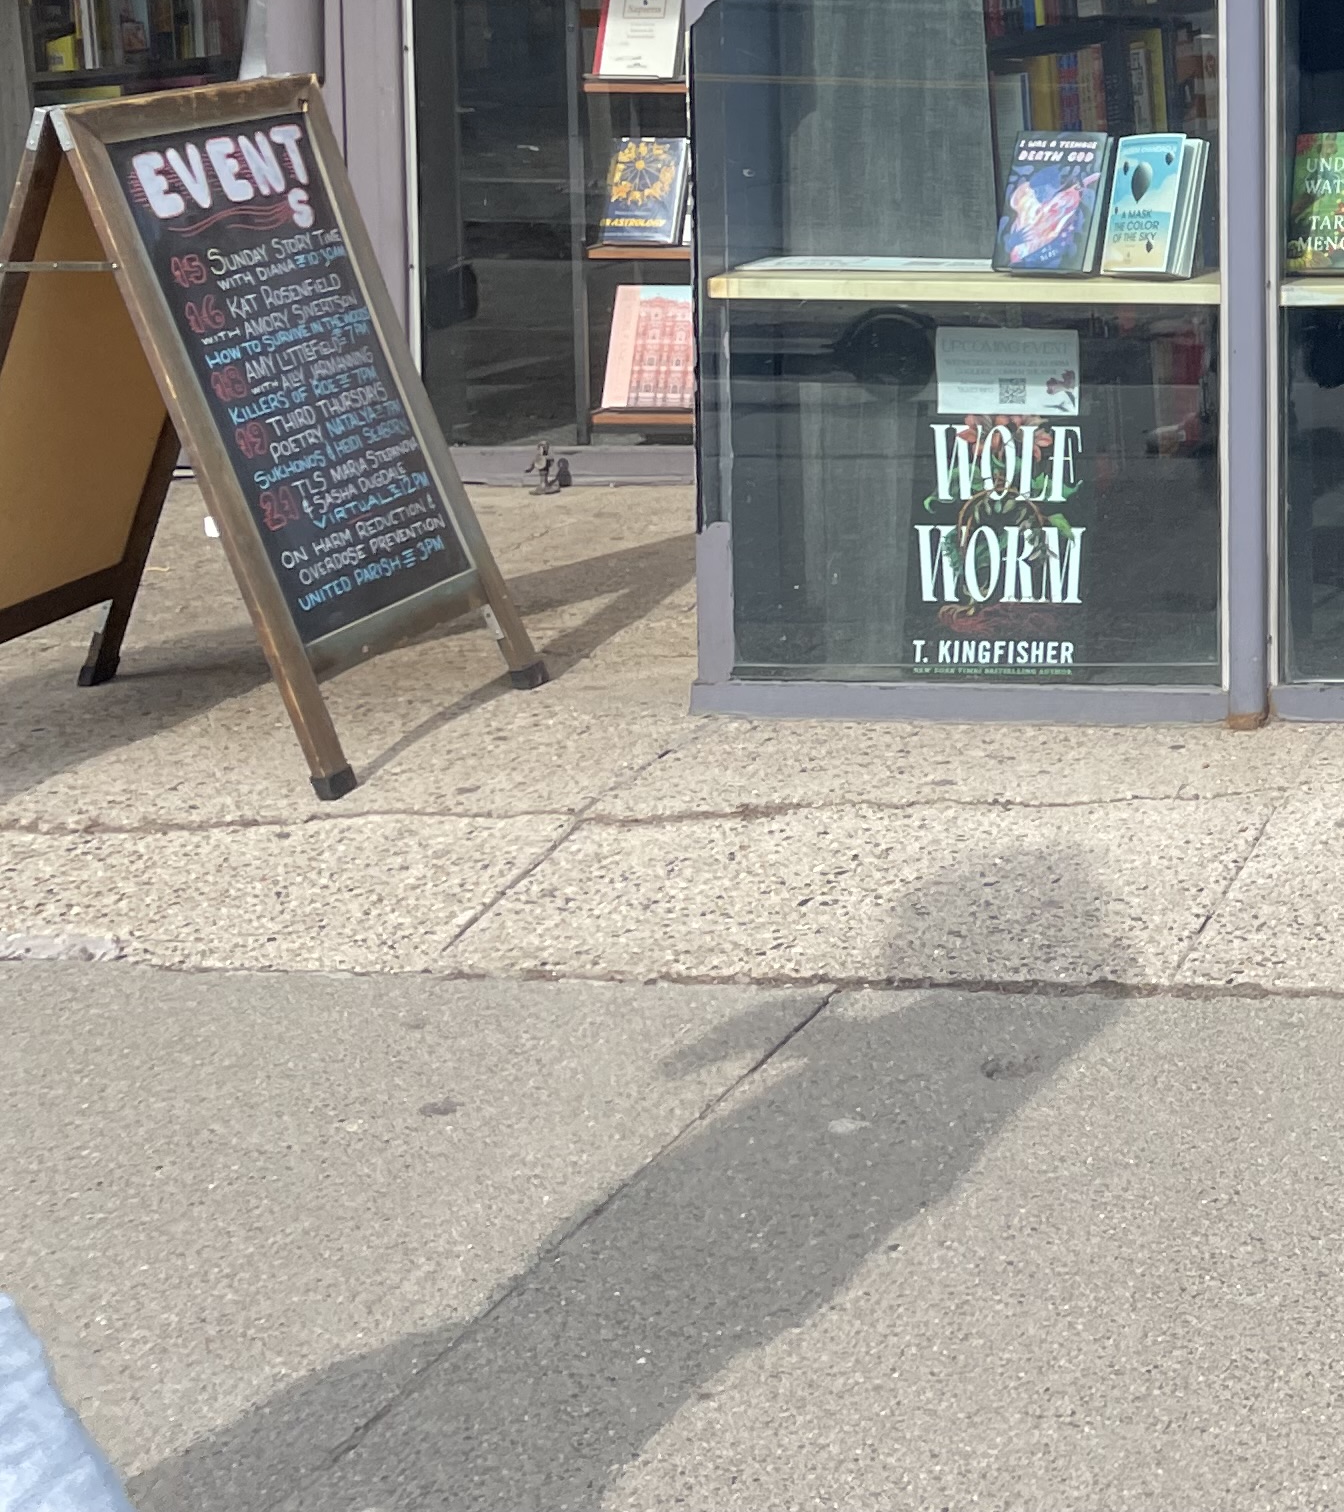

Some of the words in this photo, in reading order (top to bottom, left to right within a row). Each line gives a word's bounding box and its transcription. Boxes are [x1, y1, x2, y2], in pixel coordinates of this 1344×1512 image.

[1018, 151, 1062, 162] DEATH
[1067, 151, 1095, 162] GOD
[1126, 220, 1160, 231] COLOR
[1139, 232, 1157, 242] SKY
[206, 244, 268, 276] SUNDAY
[271, 234, 312, 259] STORY
[226, 294, 257, 320] KAT
[260, 273, 341, 310] ROSENFIELD
[228, 391, 290, 425] KILLERS
[291, 386, 308, 403] OF
[313, 378, 338, 398] ROE
[269, 427, 325, 463] POETRY
[325, 406, 376, 438] NATALYA
[929, 423, 1083, 503] WOLF
[313, 492, 394, 529] VIRTUAL
[299, 544, 366, 585] OVERDOSE
[369, 513, 446, 555] PREVENTION
[914, 524, 1086, 604] WORM
[298, 576, 351, 611] UNITED
[353, 556, 402, 586] PARISH
[418, 535, 445, 561] 3PM
[912, 640, 928, 664] T.
[938, 640, 1074, 664] KINGFISHER
